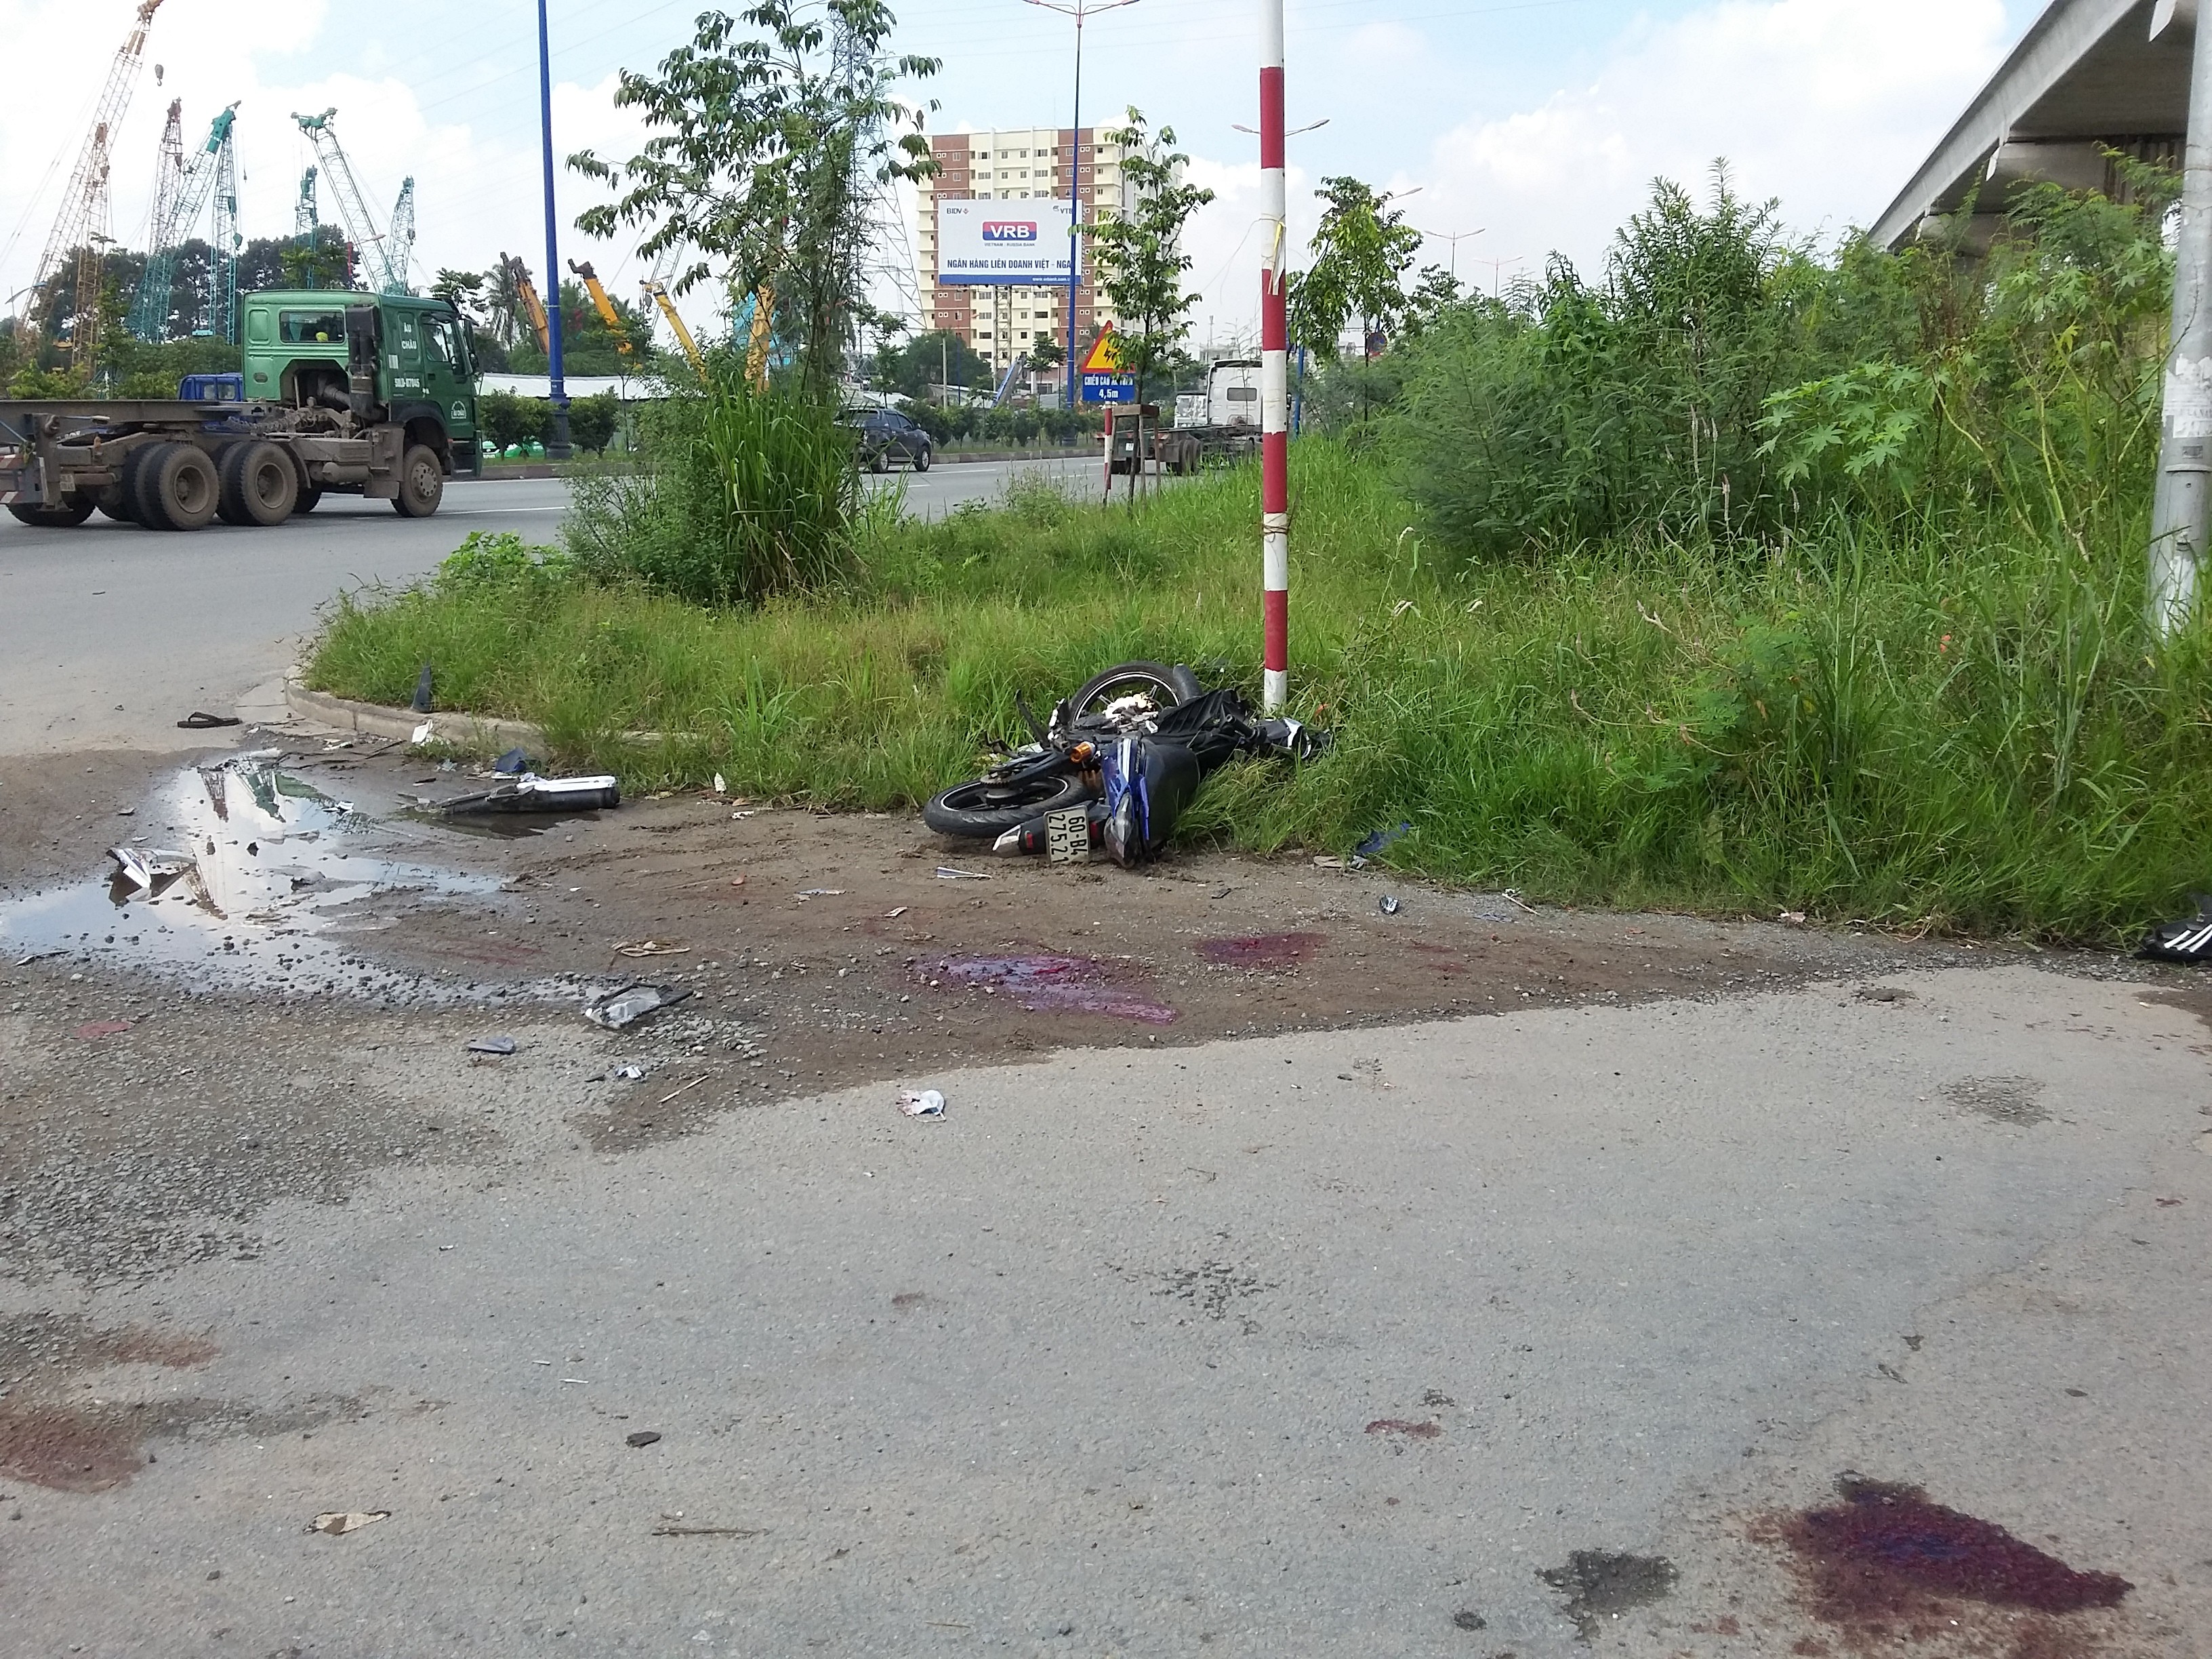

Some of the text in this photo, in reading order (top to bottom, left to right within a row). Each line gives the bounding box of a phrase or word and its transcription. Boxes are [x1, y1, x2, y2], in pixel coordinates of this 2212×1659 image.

[989, 225, 1030, 238] VRB
[947, 258, 967, 268] NGÂN
[969, 258, 989, 268] HÀNG
[991, 258, 1006, 268] LIÊN
[1008, 260, 1033, 268] DOANH
[1035, 258, 1050, 270] VIỆT
[1057, 260, 1071, 268] NGA
[1100, 376, 1110, 386] CAO
[1099, 388, 1119, 400] 4,5m
[1048, 814, 1069, 863] 275.21
